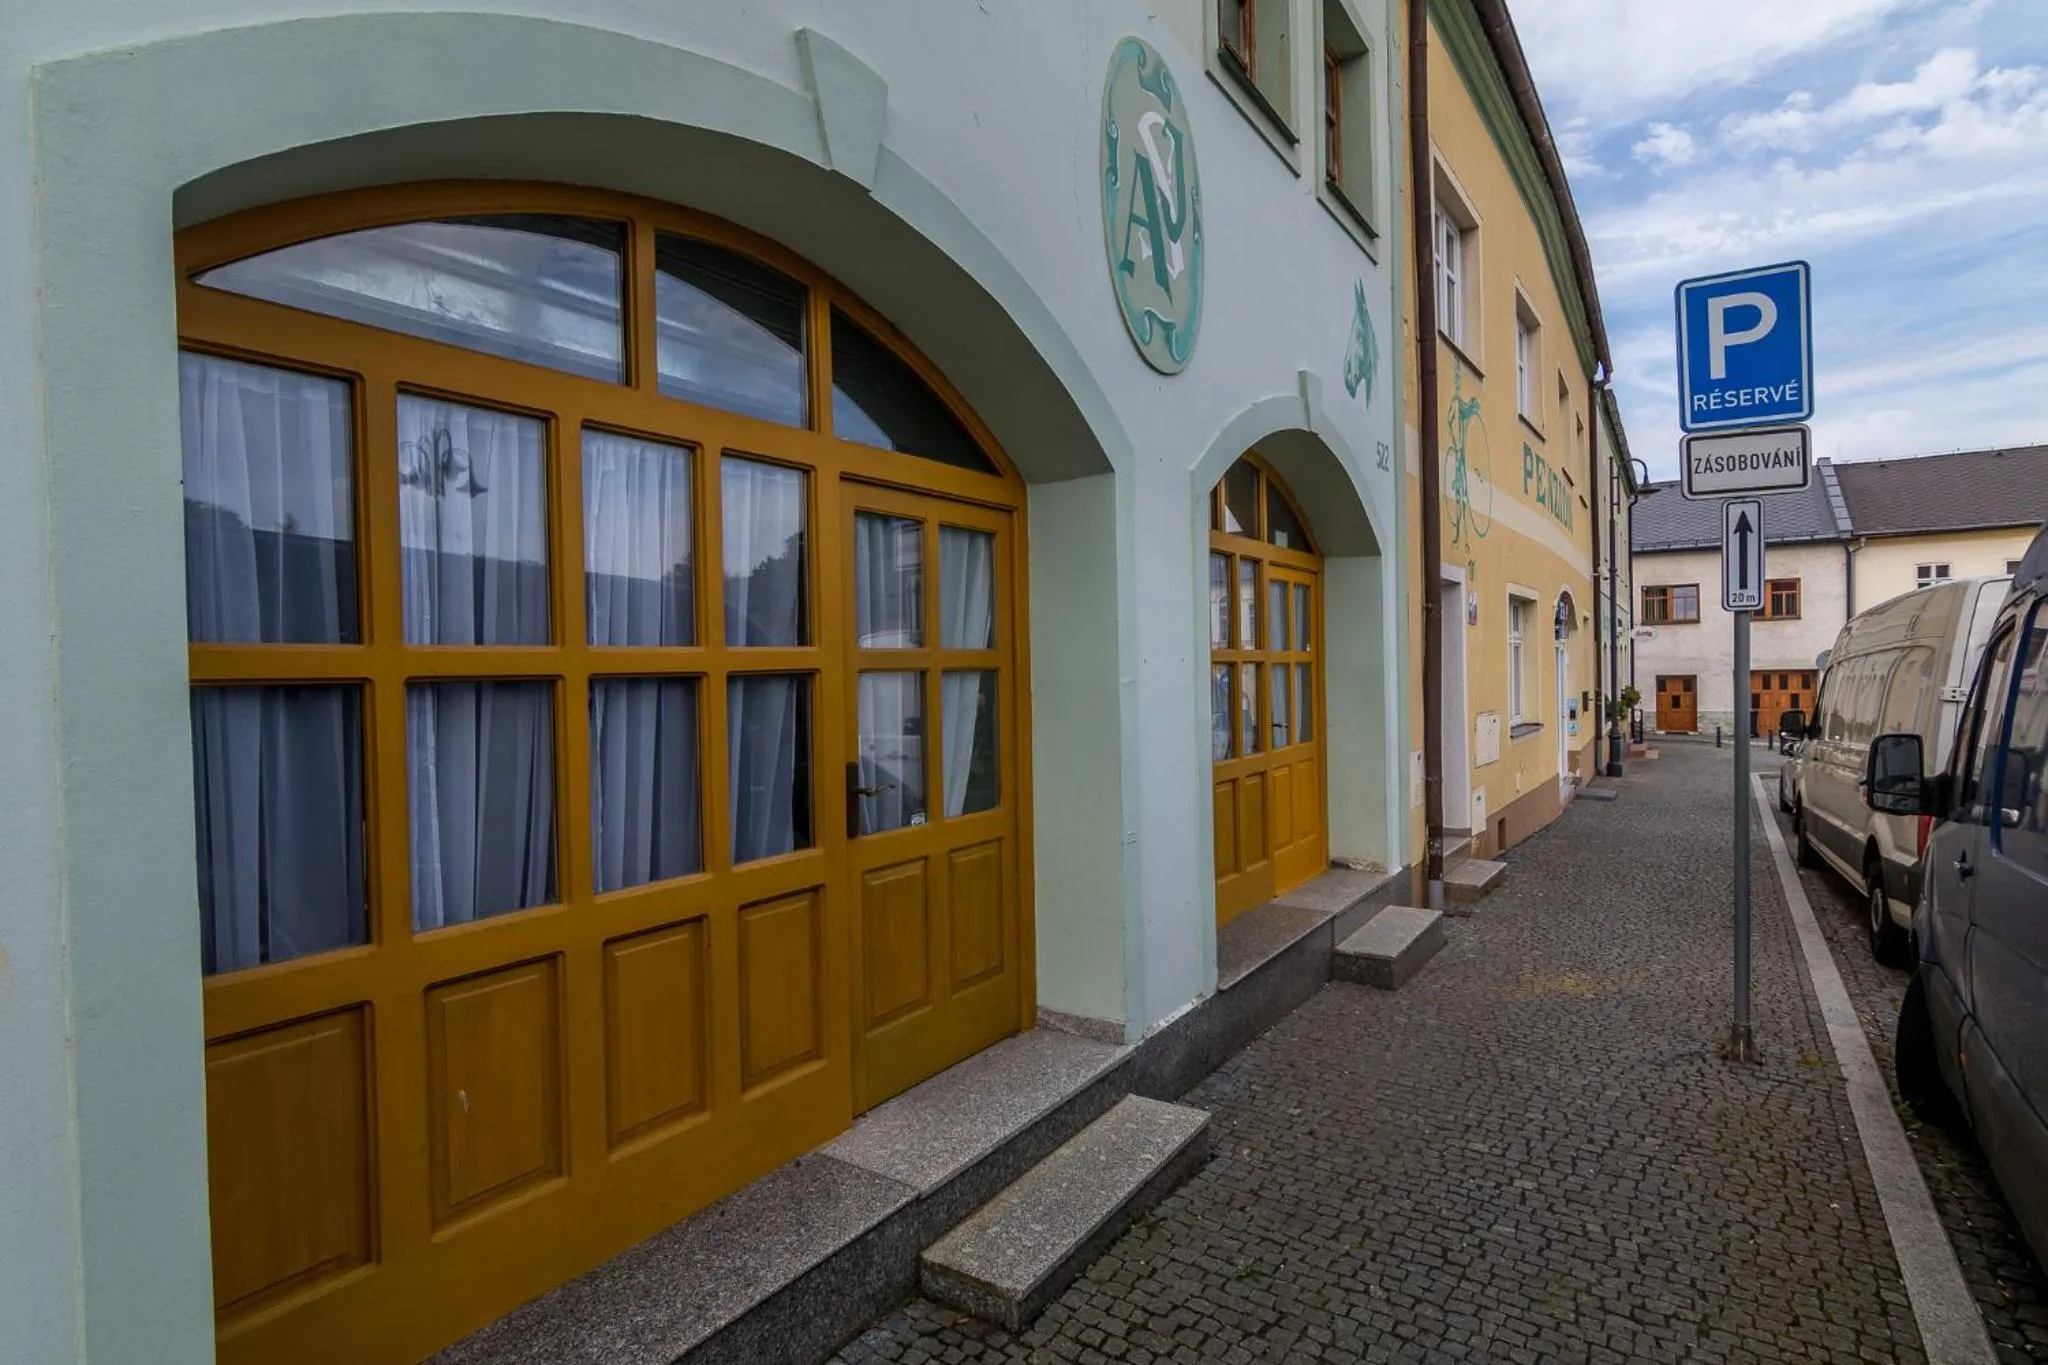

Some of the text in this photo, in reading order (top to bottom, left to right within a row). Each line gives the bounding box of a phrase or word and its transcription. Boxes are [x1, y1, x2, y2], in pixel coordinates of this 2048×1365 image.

[1707, 291, 1778, 380] P
[1693, 379, 1799, 412] RÉSERVÉ
[1376, 440, 1390, 472] 522
[1694, 446, 1802, 475] ZÁSOBOVÁNÍ
[1732, 592, 1755, 603] 20 m
